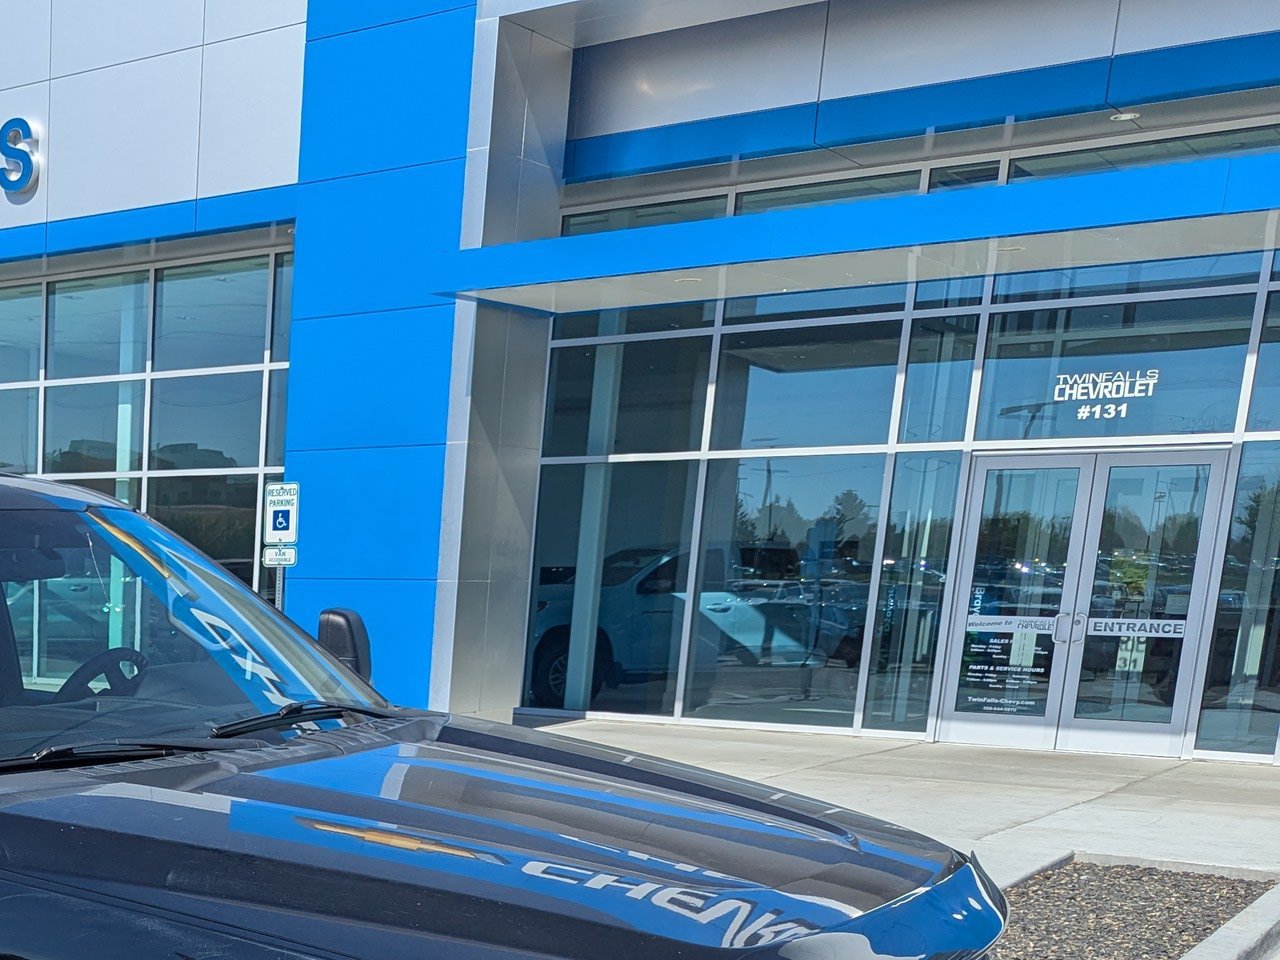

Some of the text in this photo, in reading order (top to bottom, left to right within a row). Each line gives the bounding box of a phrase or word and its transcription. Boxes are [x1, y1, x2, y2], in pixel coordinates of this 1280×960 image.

[1053, 380, 1158, 401] CHEVROLET
[1077, 403, 1128, 420] #131
[267, 488, 297, 497] RESERVED
[268, 499, 295, 508] PARKING
[968, 620, 1003, 628] Welcome
[1093, 621, 1184, 634] ENTRANCE
